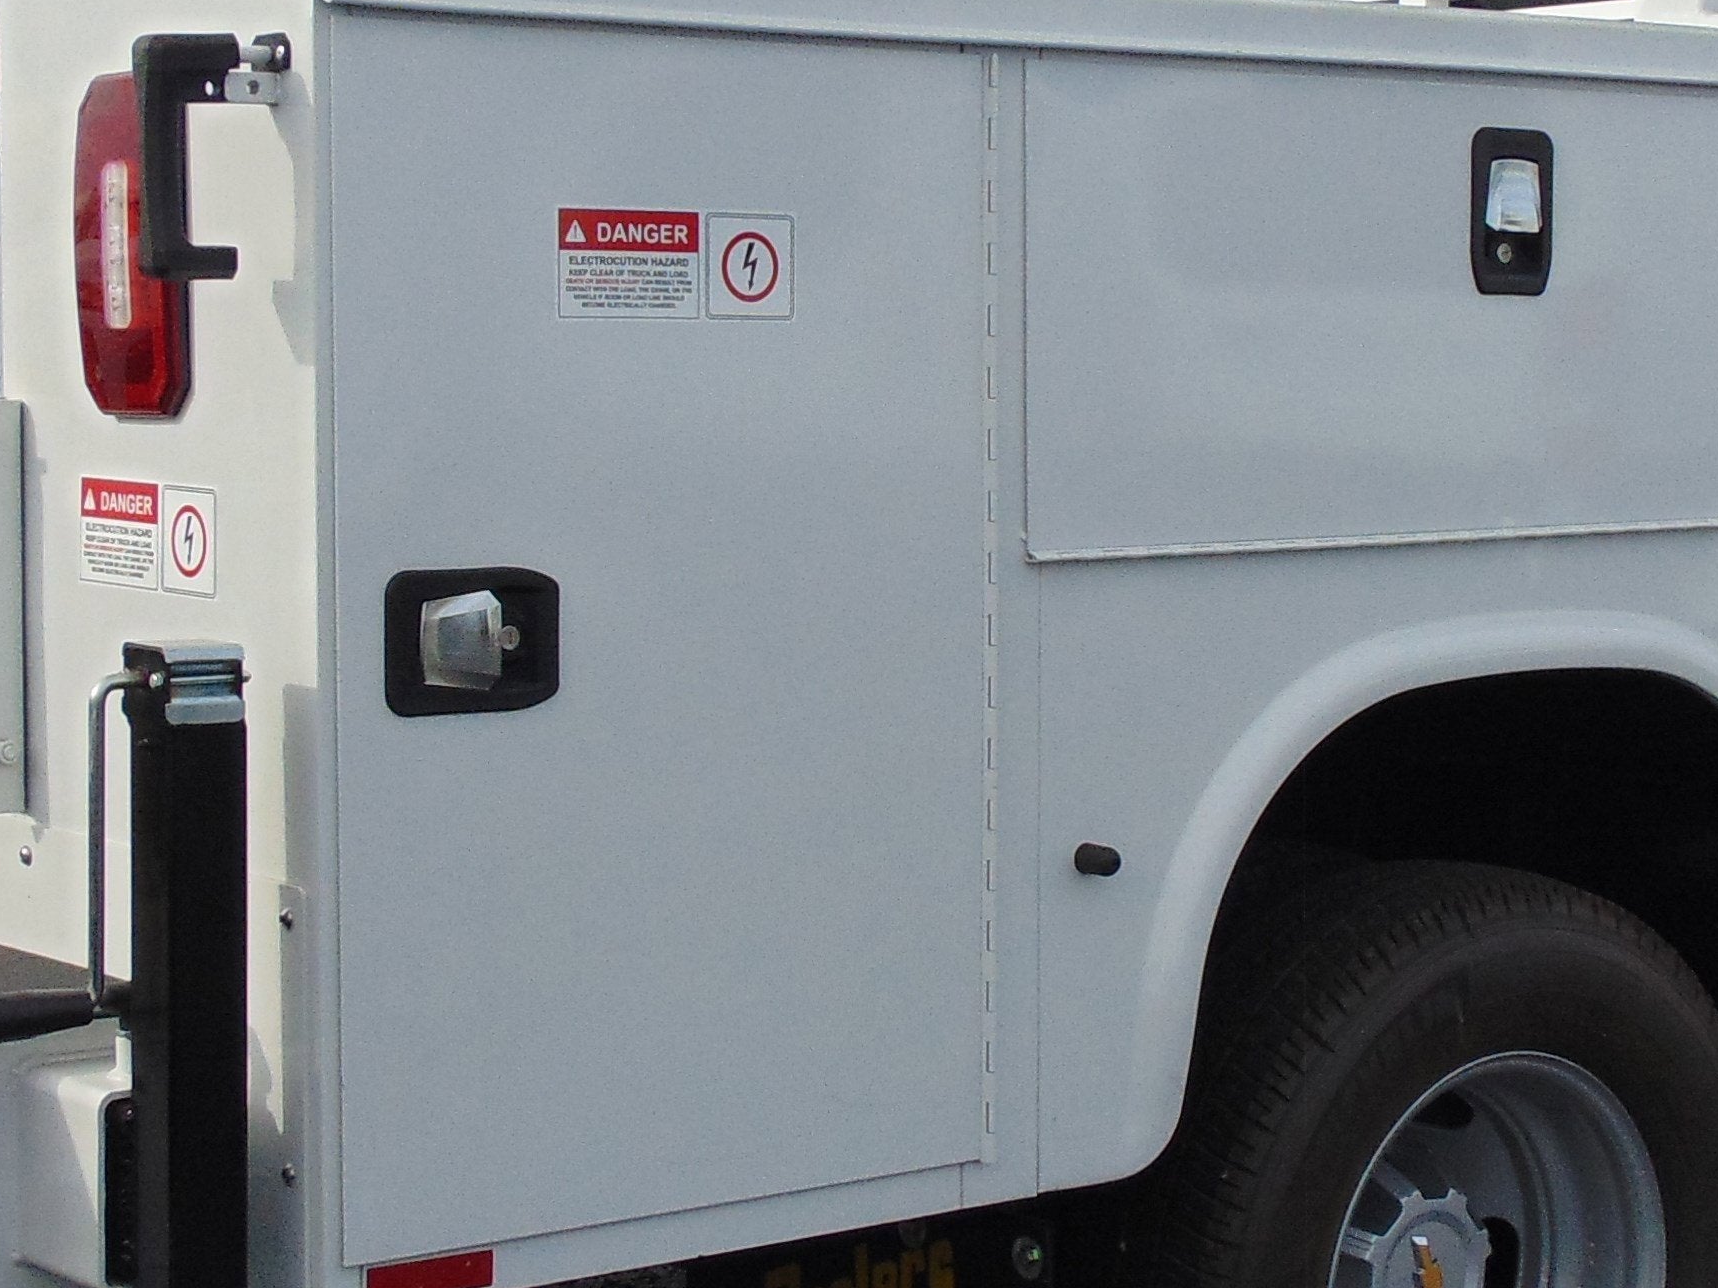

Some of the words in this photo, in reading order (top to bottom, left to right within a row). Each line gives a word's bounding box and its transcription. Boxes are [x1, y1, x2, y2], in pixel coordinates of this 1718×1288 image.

[596, 222, 689, 245] DANGER
[568, 256, 648, 266] ELECTROCUTION
[651, 257, 689, 267] HAZARD
[100, 490, 153, 516] DANGER
